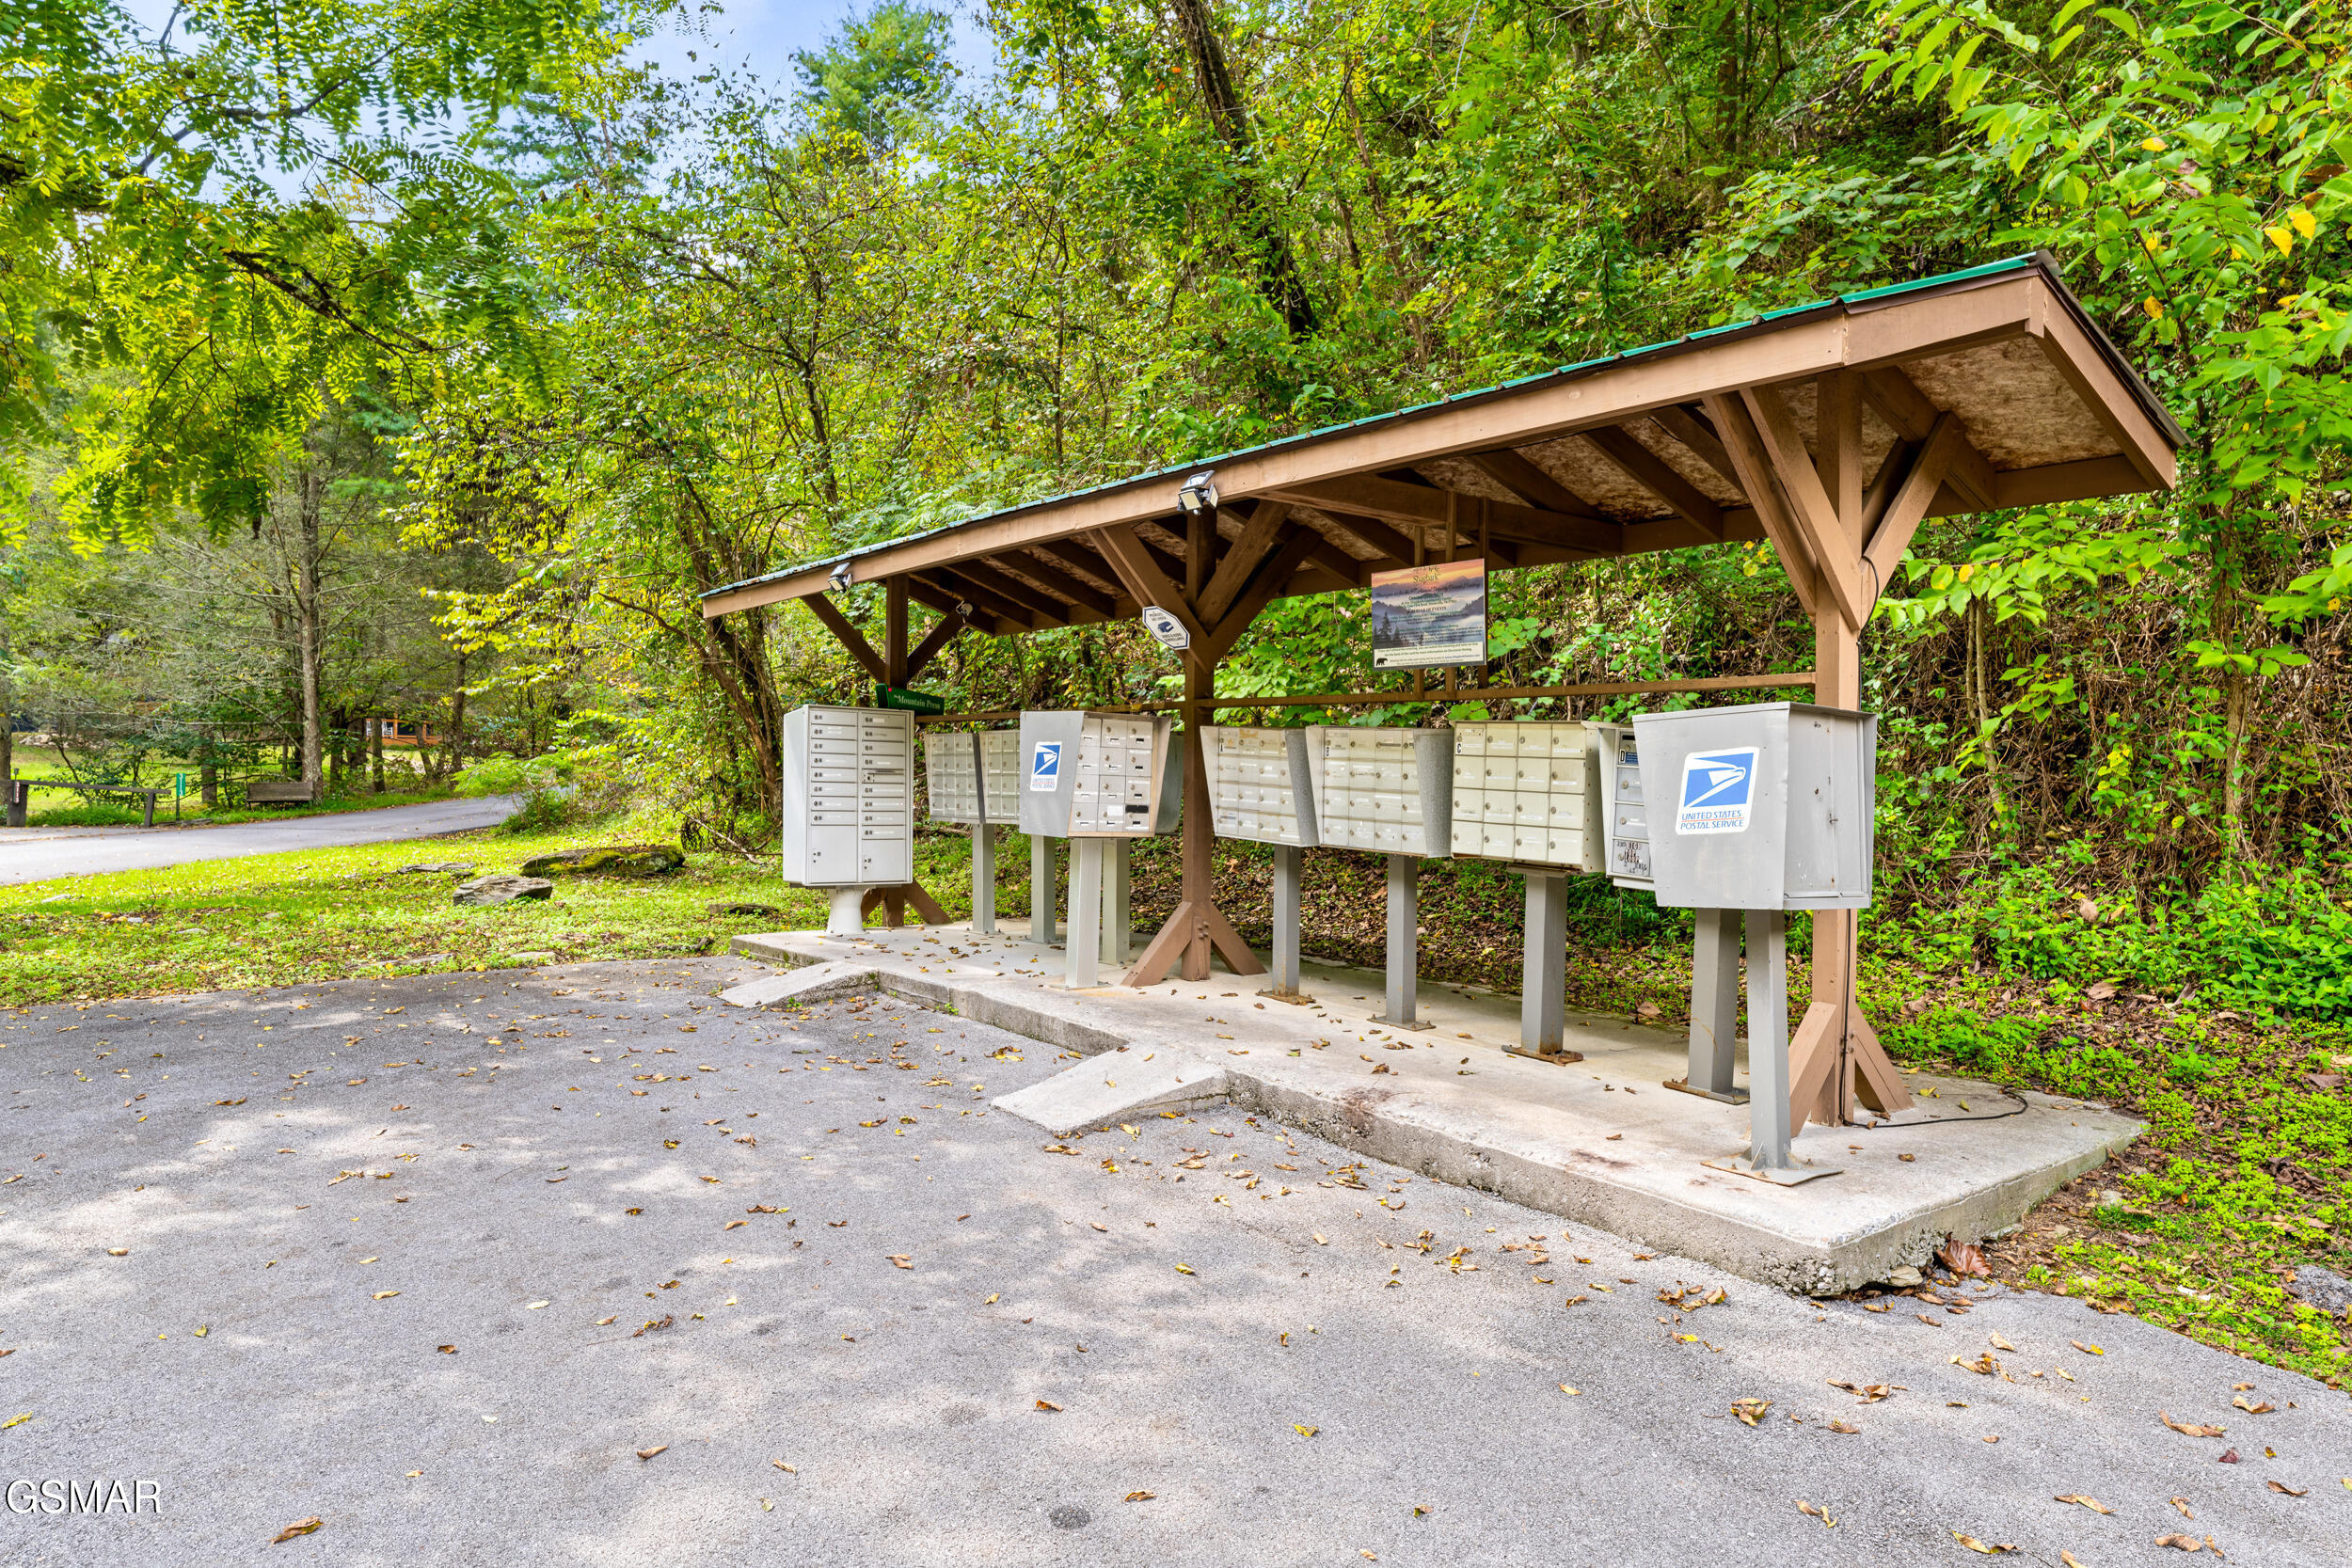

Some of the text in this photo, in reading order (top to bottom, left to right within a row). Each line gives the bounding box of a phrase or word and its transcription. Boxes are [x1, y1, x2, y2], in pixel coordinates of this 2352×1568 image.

[897, 694, 941, 710] Mountain Press
[1456, 743, 1462, 753] C
[1620, 750, 1626, 762] D
[1681, 809, 1741, 821] UNITED STATES
[1680, 819, 1743, 831] POSTAL SERVICE
